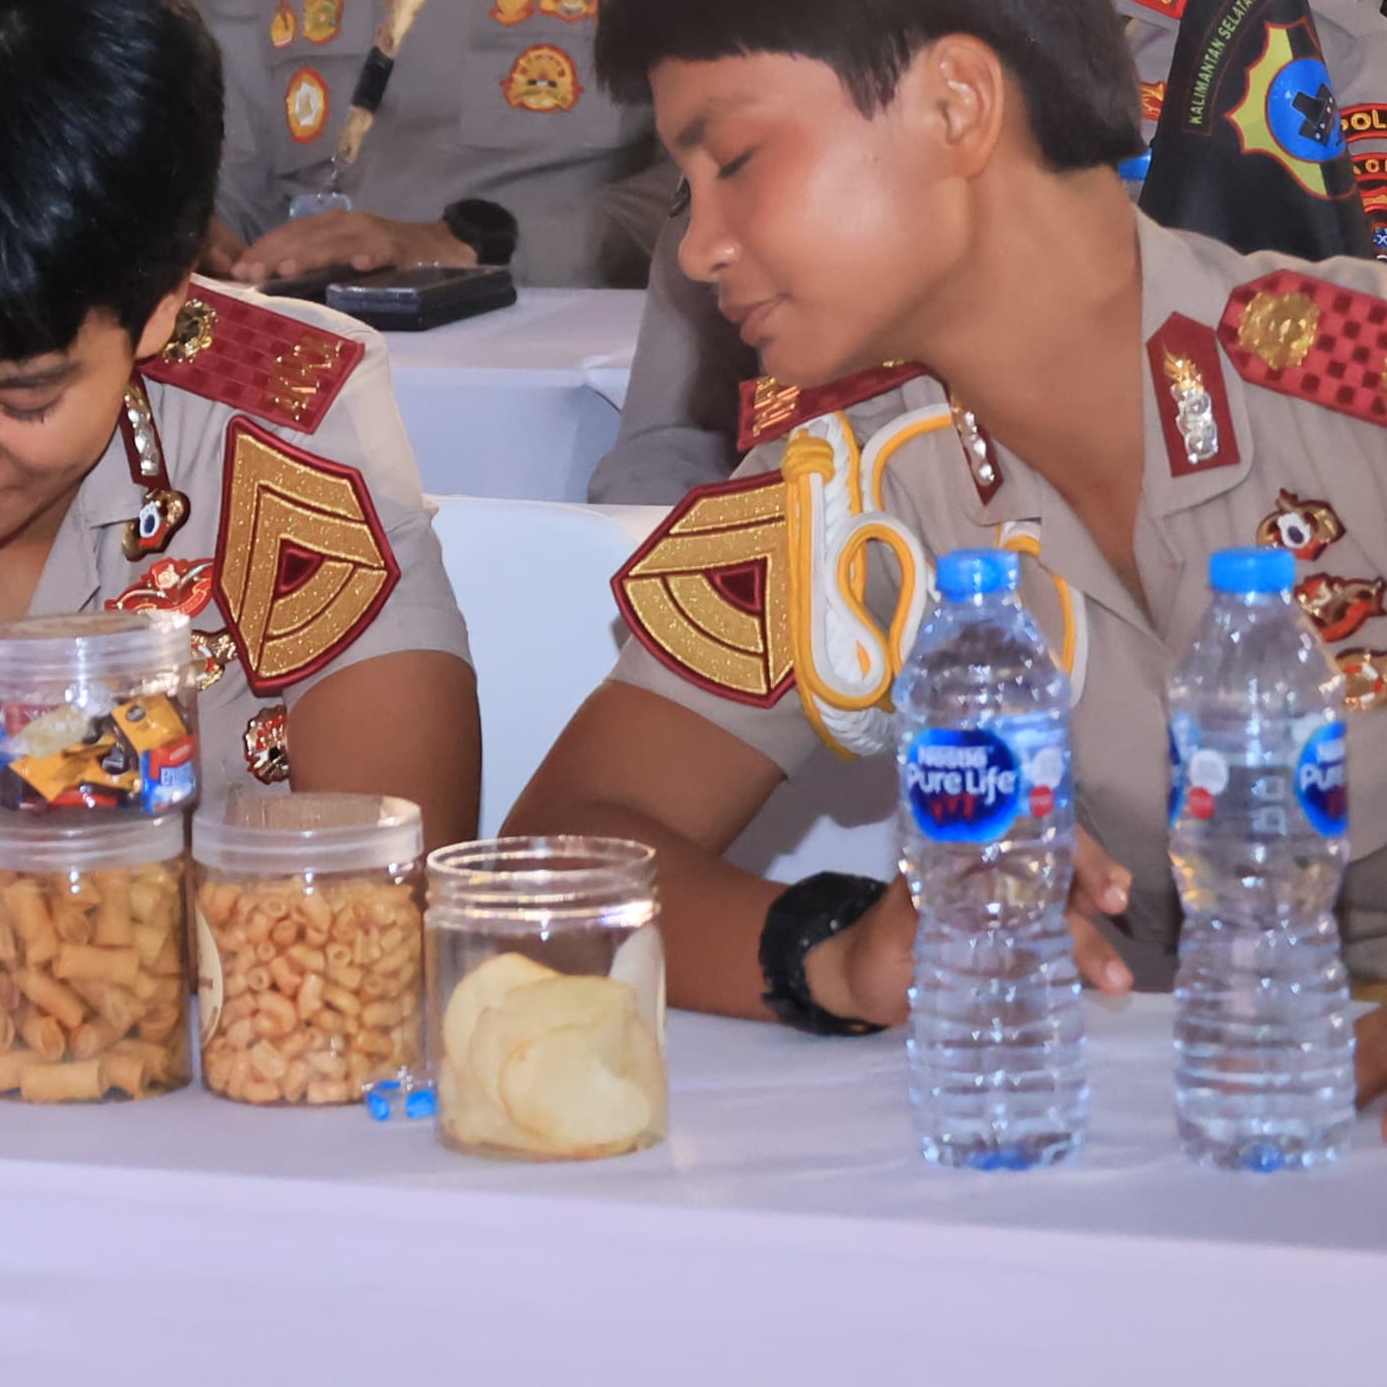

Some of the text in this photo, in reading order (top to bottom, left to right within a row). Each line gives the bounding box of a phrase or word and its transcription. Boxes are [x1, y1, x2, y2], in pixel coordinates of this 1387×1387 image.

[1188, 38, 1226, 126] KALIMANTAN
[907, 762, 1017, 806] Pure Life
